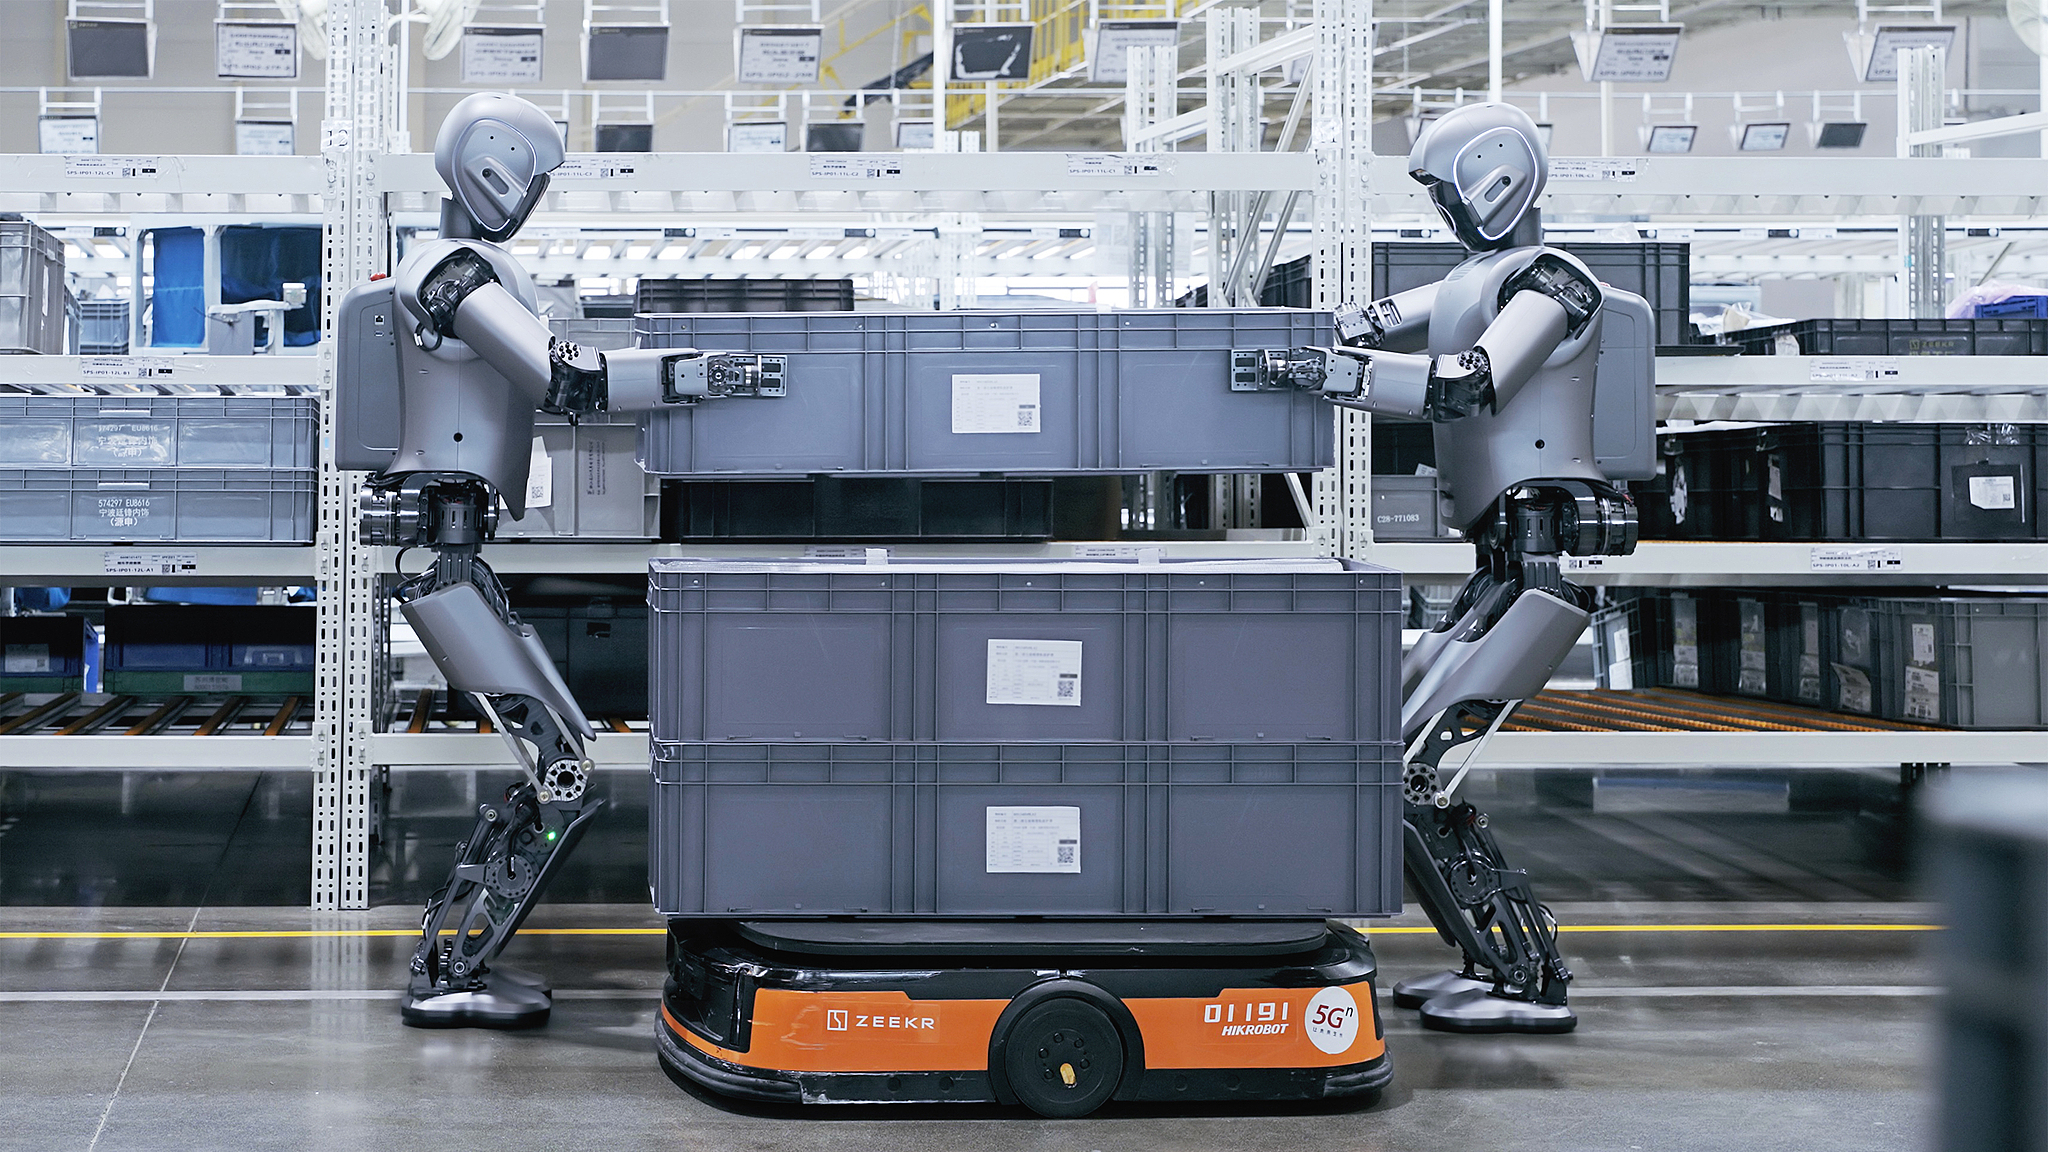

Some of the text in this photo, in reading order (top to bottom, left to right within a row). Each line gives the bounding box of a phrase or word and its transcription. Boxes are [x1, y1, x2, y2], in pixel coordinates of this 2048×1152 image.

[98, 498, 151, 507] 574297 EU8616
[1377, 513, 1420, 524] C28-771083
[1203, 1001, 1289, 1023] 01191
[855, 1015, 936, 1030] ZEEKR
[1221, 1023, 1290, 1036] HIKROBOT
